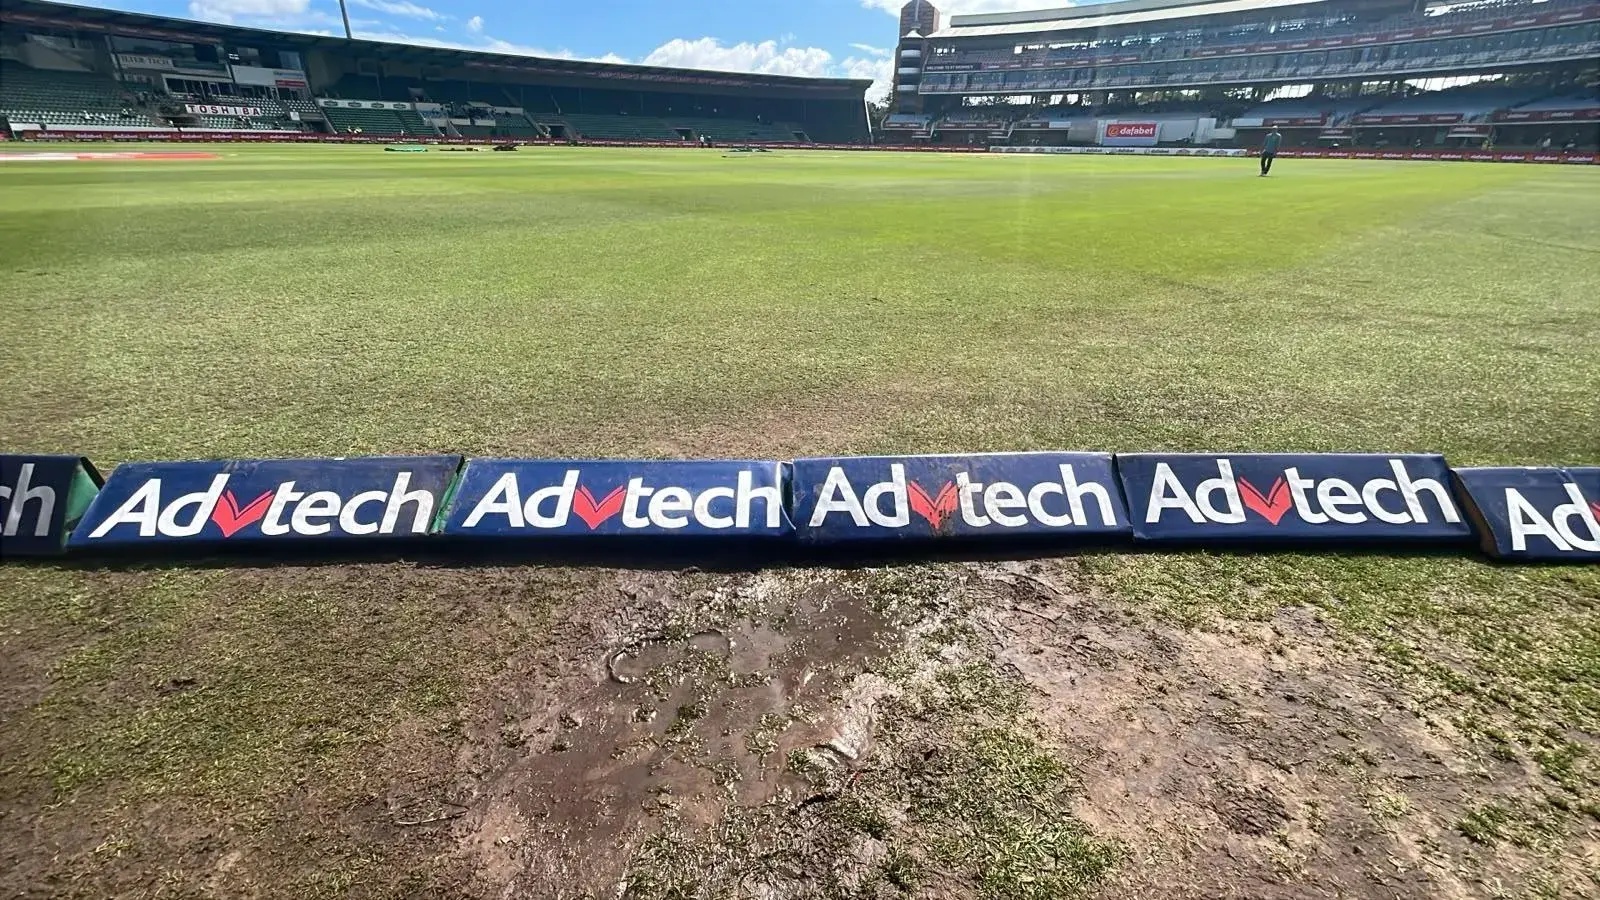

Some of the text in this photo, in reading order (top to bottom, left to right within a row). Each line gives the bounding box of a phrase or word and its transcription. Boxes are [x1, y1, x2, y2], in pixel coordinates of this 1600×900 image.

[188, 105, 260, 116] TOSHIBA
[1120, 126, 1153, 136] dafabet
[0, 463, 56, 536] h
